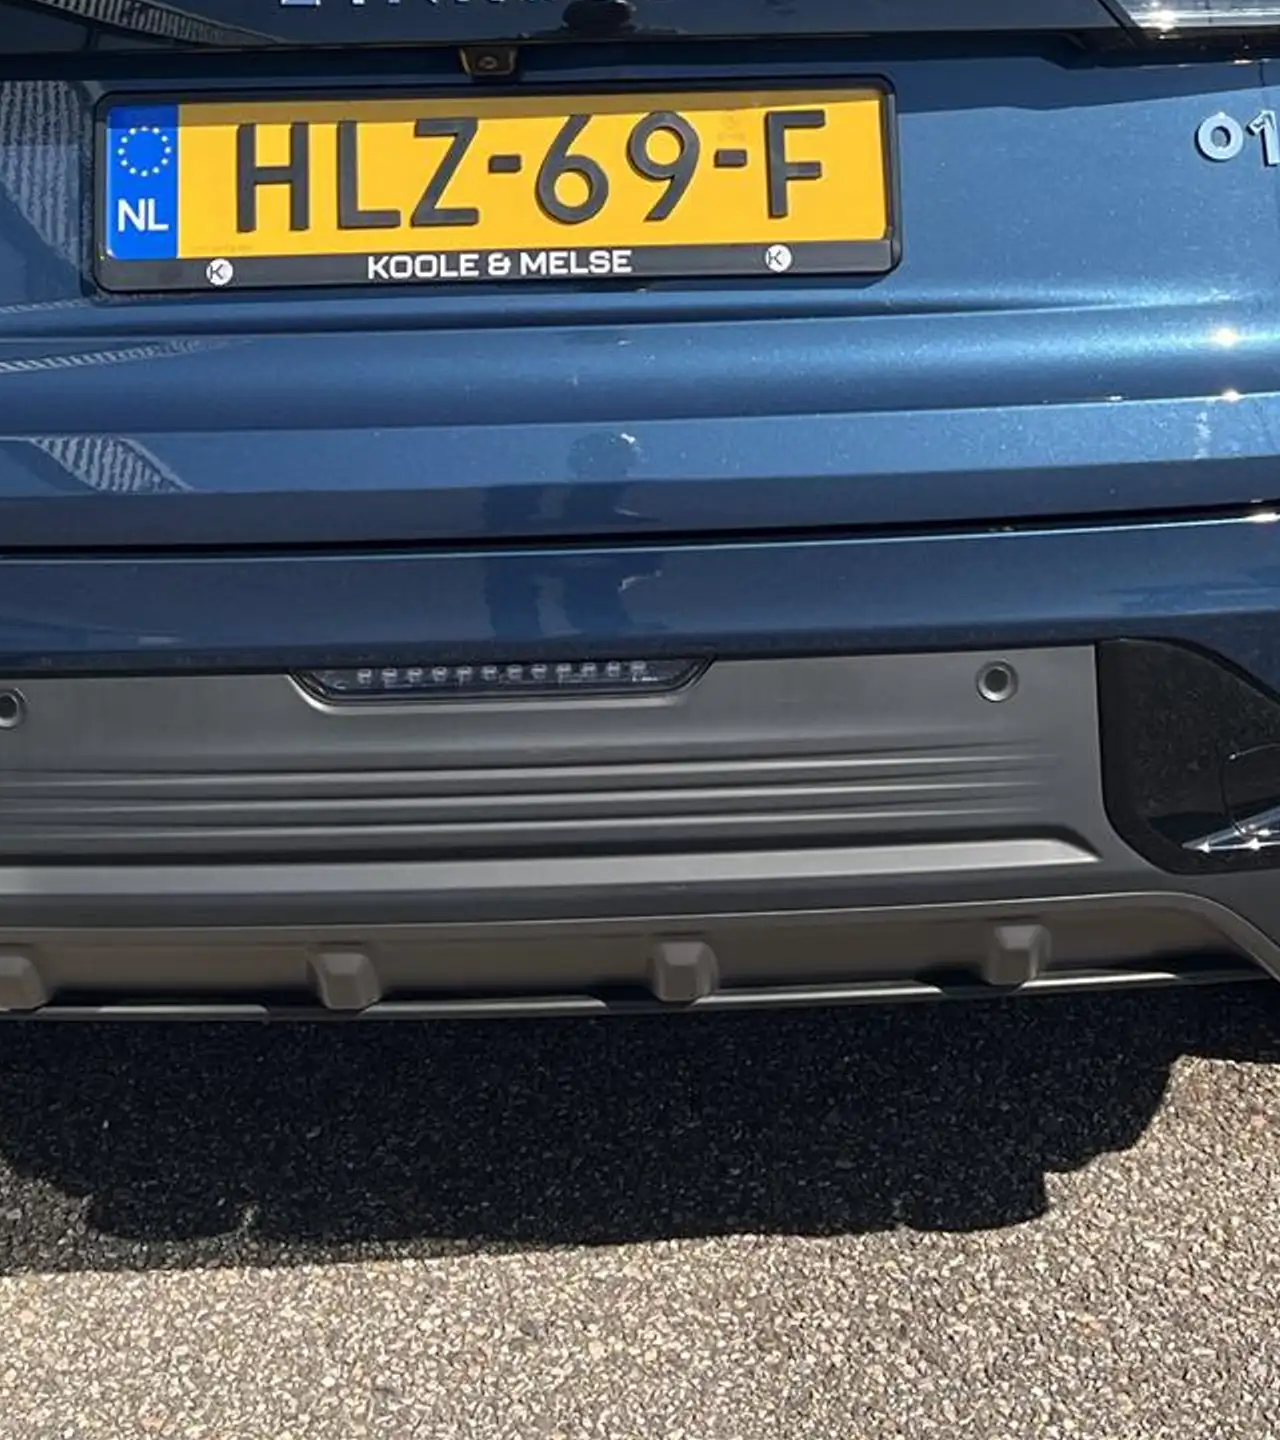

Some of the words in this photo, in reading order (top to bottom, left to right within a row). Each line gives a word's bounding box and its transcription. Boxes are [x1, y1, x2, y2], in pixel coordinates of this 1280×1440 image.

[235, 109, 825, 234] HLZ-69-F
[116, 197, 170, 233] NL
[367, 253, 480, 279] KOOLE
[488, 252, 511, 276] &
[519, 249, 632, 276] MELSE
